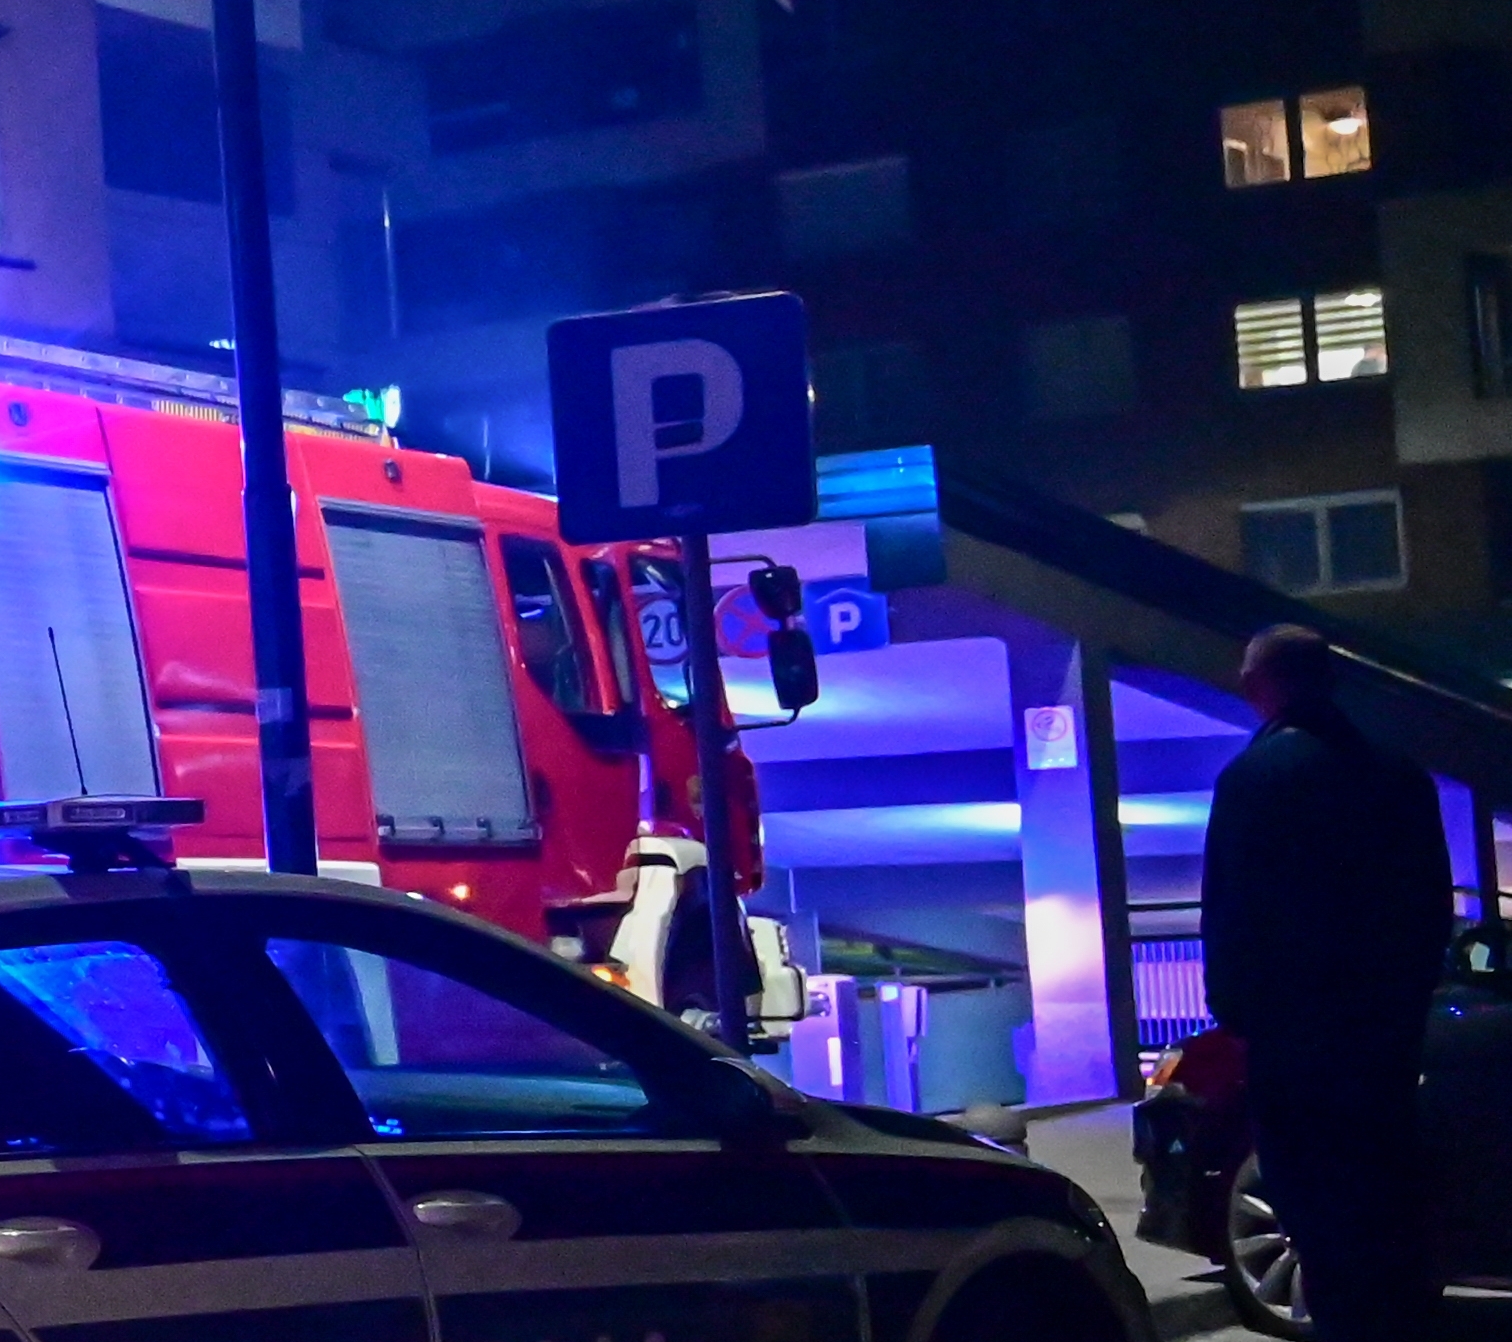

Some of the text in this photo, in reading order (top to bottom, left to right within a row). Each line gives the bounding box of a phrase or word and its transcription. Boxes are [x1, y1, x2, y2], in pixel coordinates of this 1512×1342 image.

[611, 338, 744, 509] P
[642, 612, 685, 648] 20
[828, 601, 862, 644] P
